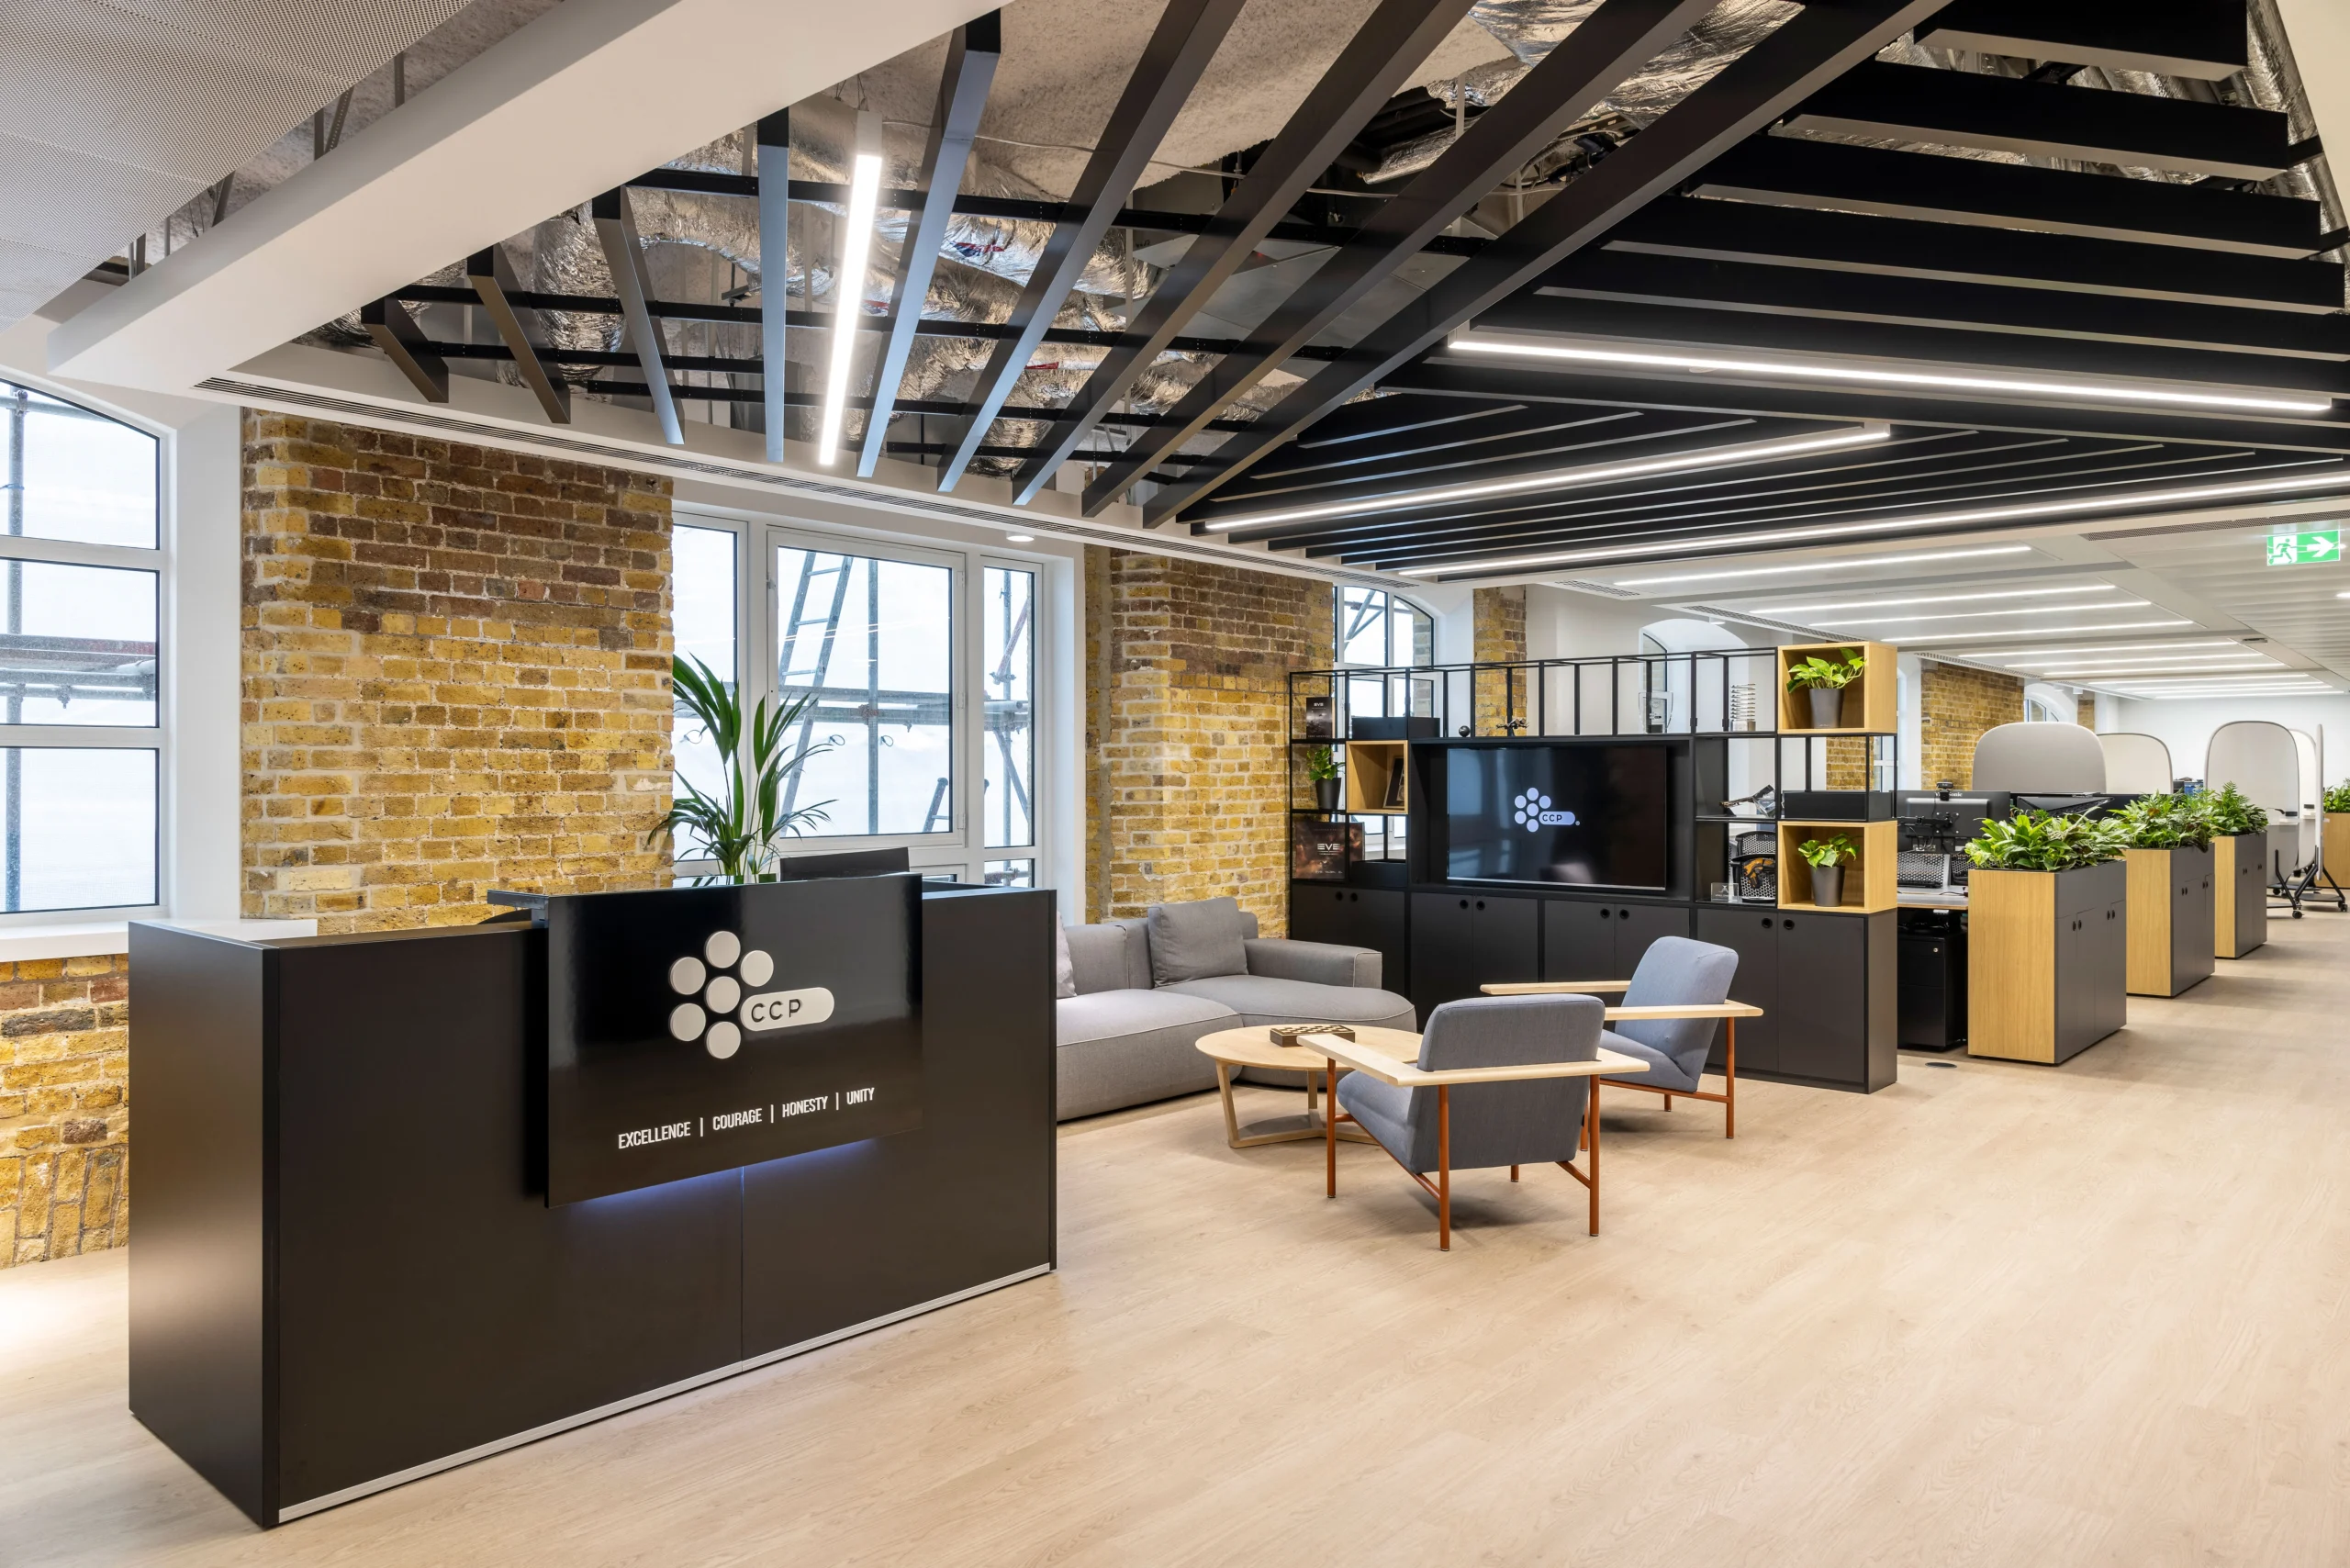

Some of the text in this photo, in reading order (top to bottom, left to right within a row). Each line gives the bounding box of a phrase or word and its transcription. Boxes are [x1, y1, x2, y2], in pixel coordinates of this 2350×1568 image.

[1316, 843, 1341, 851] EVE
[751, 998, 803, 1023] CCP
[618, 1087, 876, 1149] EXCELLENCE COURAGE HONESTY UNITY
